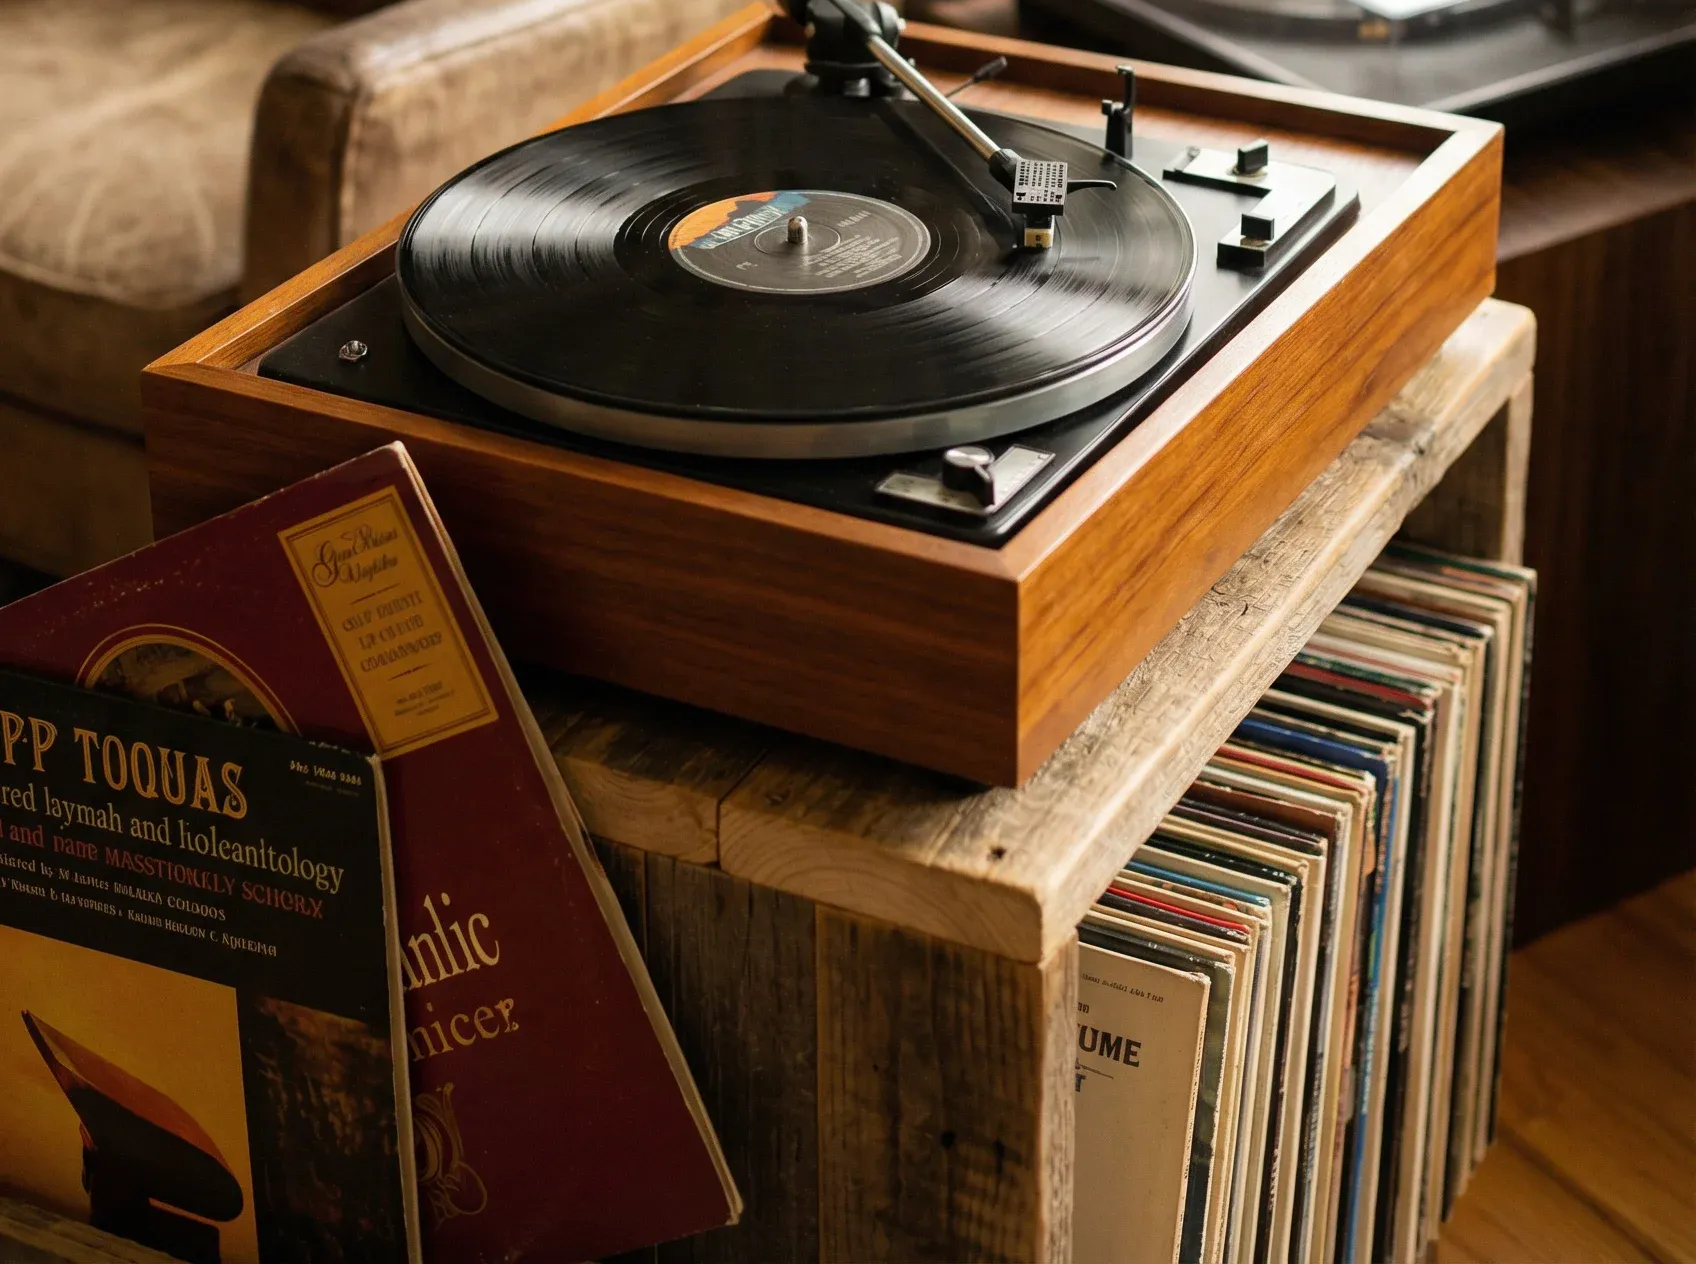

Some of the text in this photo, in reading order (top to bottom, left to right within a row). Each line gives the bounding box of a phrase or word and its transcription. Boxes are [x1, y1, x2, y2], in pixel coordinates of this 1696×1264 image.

[73, 726, 248, 820] TOQUAS
[8, 824, 45, 849] and
[43, 786, 124, 834] laymah
[130, 816, 172, 846] and
